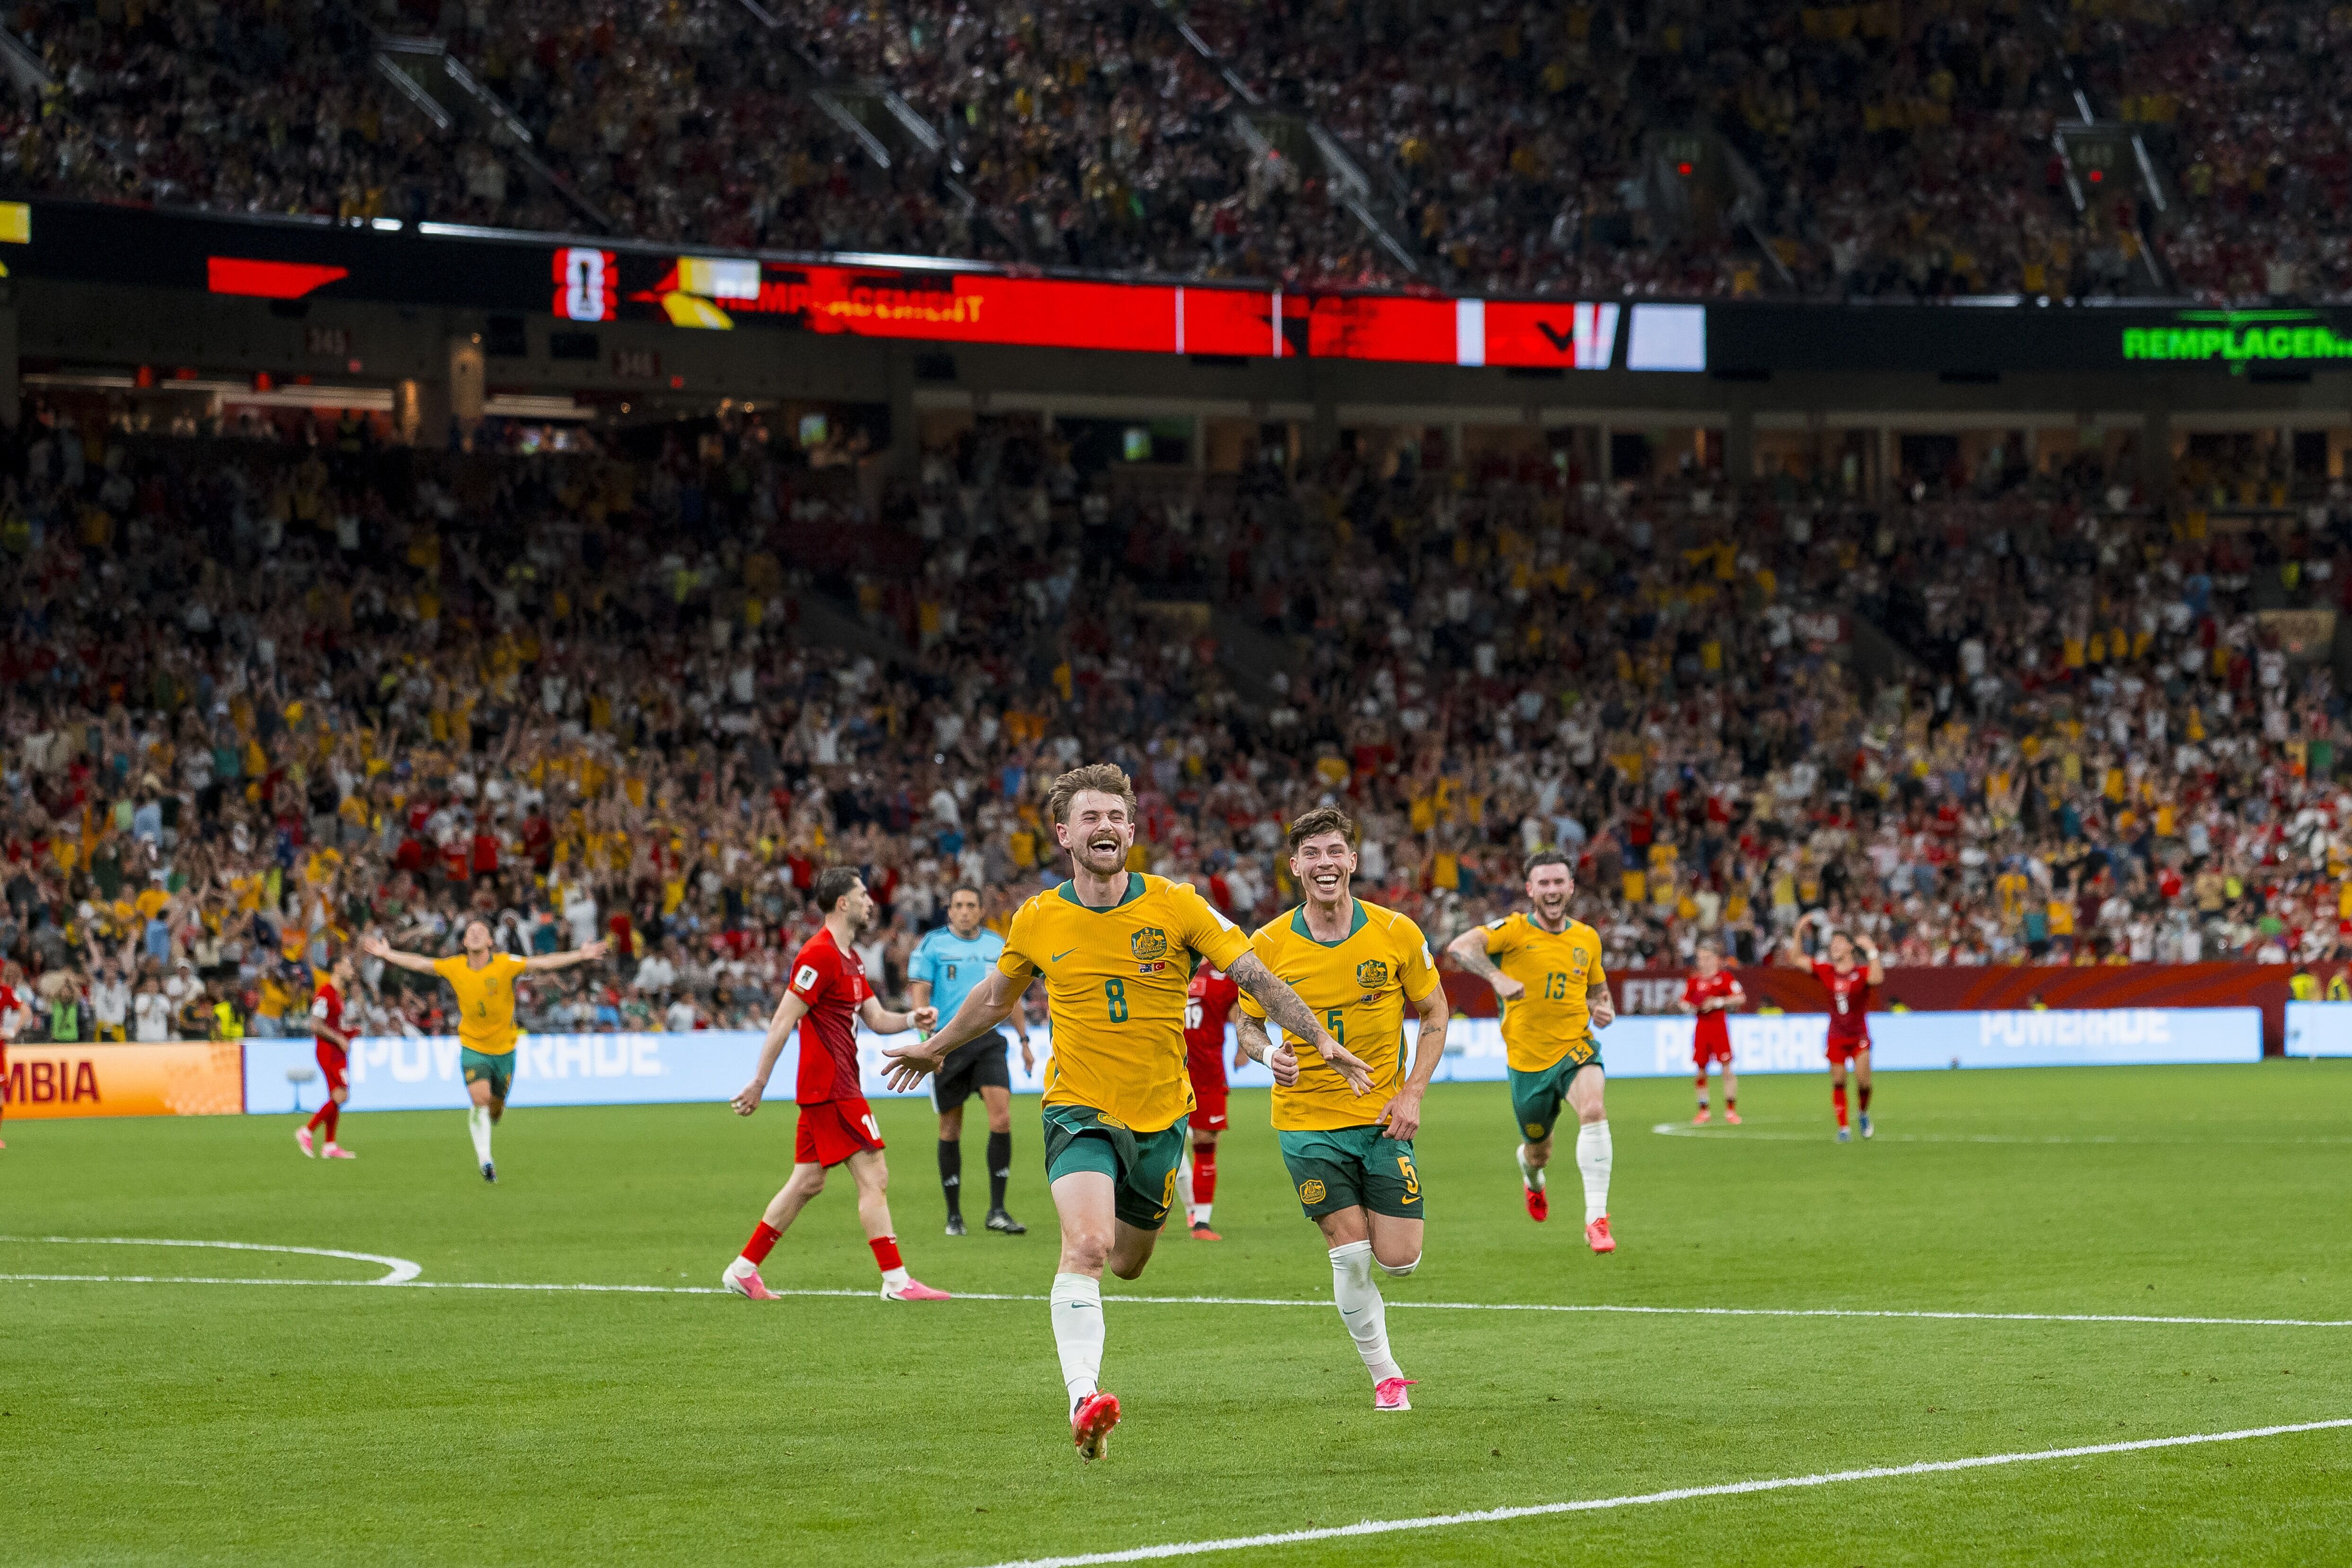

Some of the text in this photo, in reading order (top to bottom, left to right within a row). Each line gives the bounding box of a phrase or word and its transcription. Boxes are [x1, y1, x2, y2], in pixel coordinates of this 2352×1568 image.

[1105, 979, 1128, 1023] 8
[1544, 972, 1567, 1000] 13
[1327, 1010, 1344, 1046] 5
[1163, 1168, 1176, 1208] 8
[1397, 1156, 1418, 1194] 5
